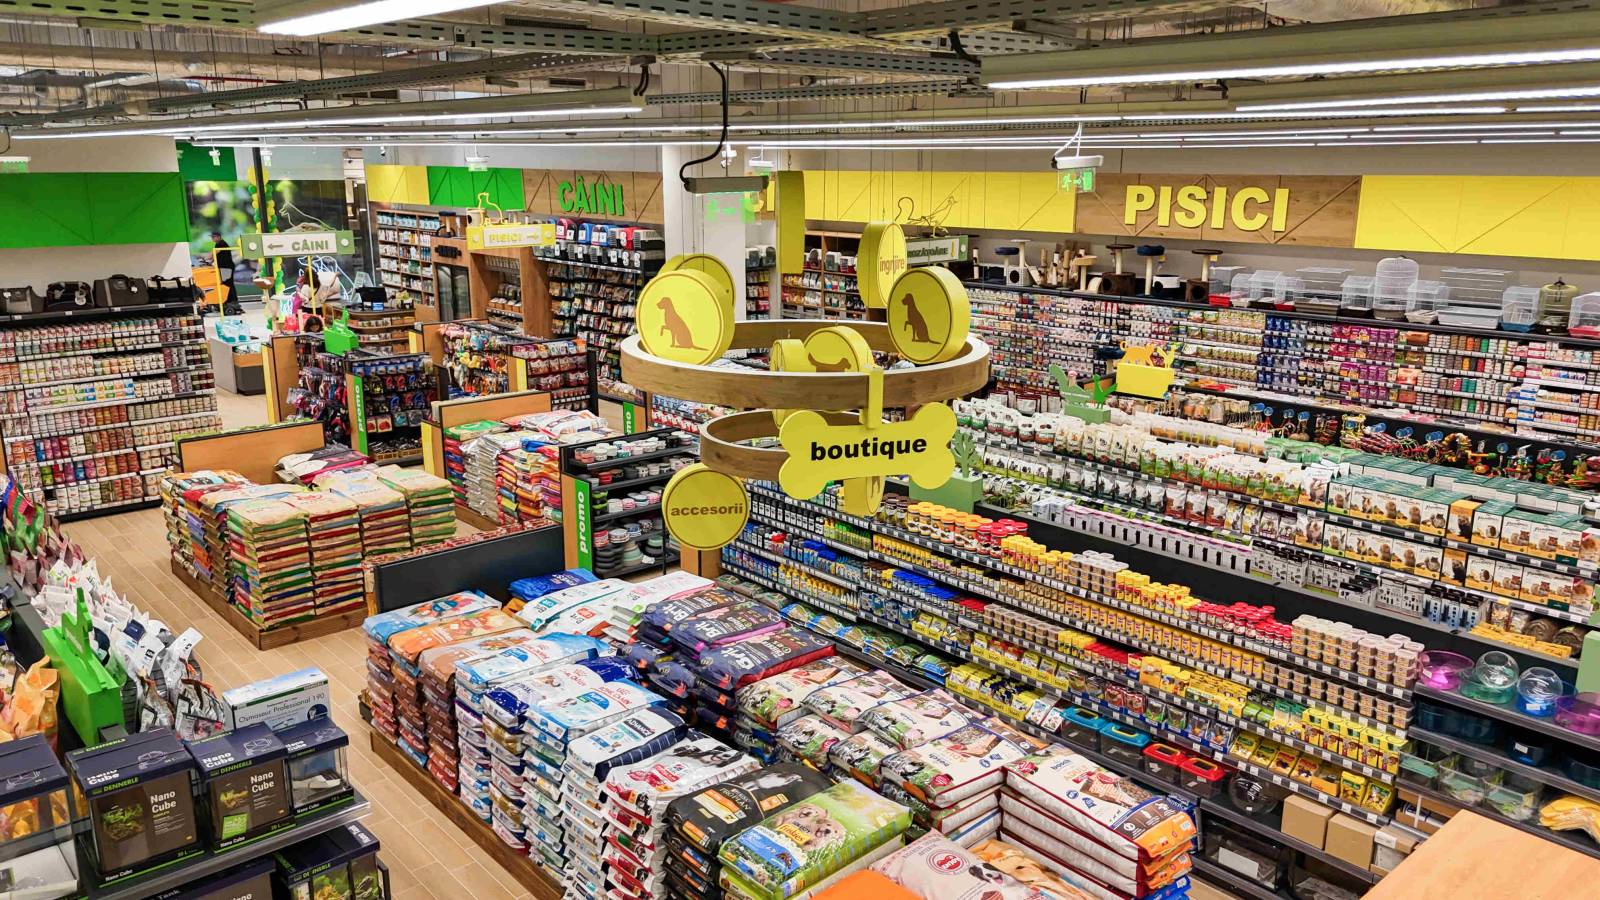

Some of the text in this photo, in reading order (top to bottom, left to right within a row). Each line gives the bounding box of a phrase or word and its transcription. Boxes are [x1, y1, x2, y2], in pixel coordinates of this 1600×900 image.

[557, 175, 625, 217] CÂINI
[1124, 184, 1290, 232] PISICI
[291, 238, 329, 252] CÂINI
[355, 384, 365, 433] promo
[810, 434, 927, 463] boutique
[670, 502, 744, 518] accesorii
[577, 490, 588, 555] promo
[694, 621, 722, 638] Brit
[720, 647, 756, 670] Brit
[273, 698, 311, 713] Professional
[202, 752, 231, 764] Nano
[205, 756, 235, 768] Cube
[88, 773, 120, 785] Cube
[103, 777, 139, 792] DENNERLE
[250, 771, 274, 784] Nano
[251, 780, 275, 793] Cube
[150, 791, 176, 804] Nano
[151, 800, 177, 813] Cube
[780, 824, 804, 842] Friskies
[220, 836, 245, 848] Nano Cube
[105, 868, 133, 882] Nano Cube
